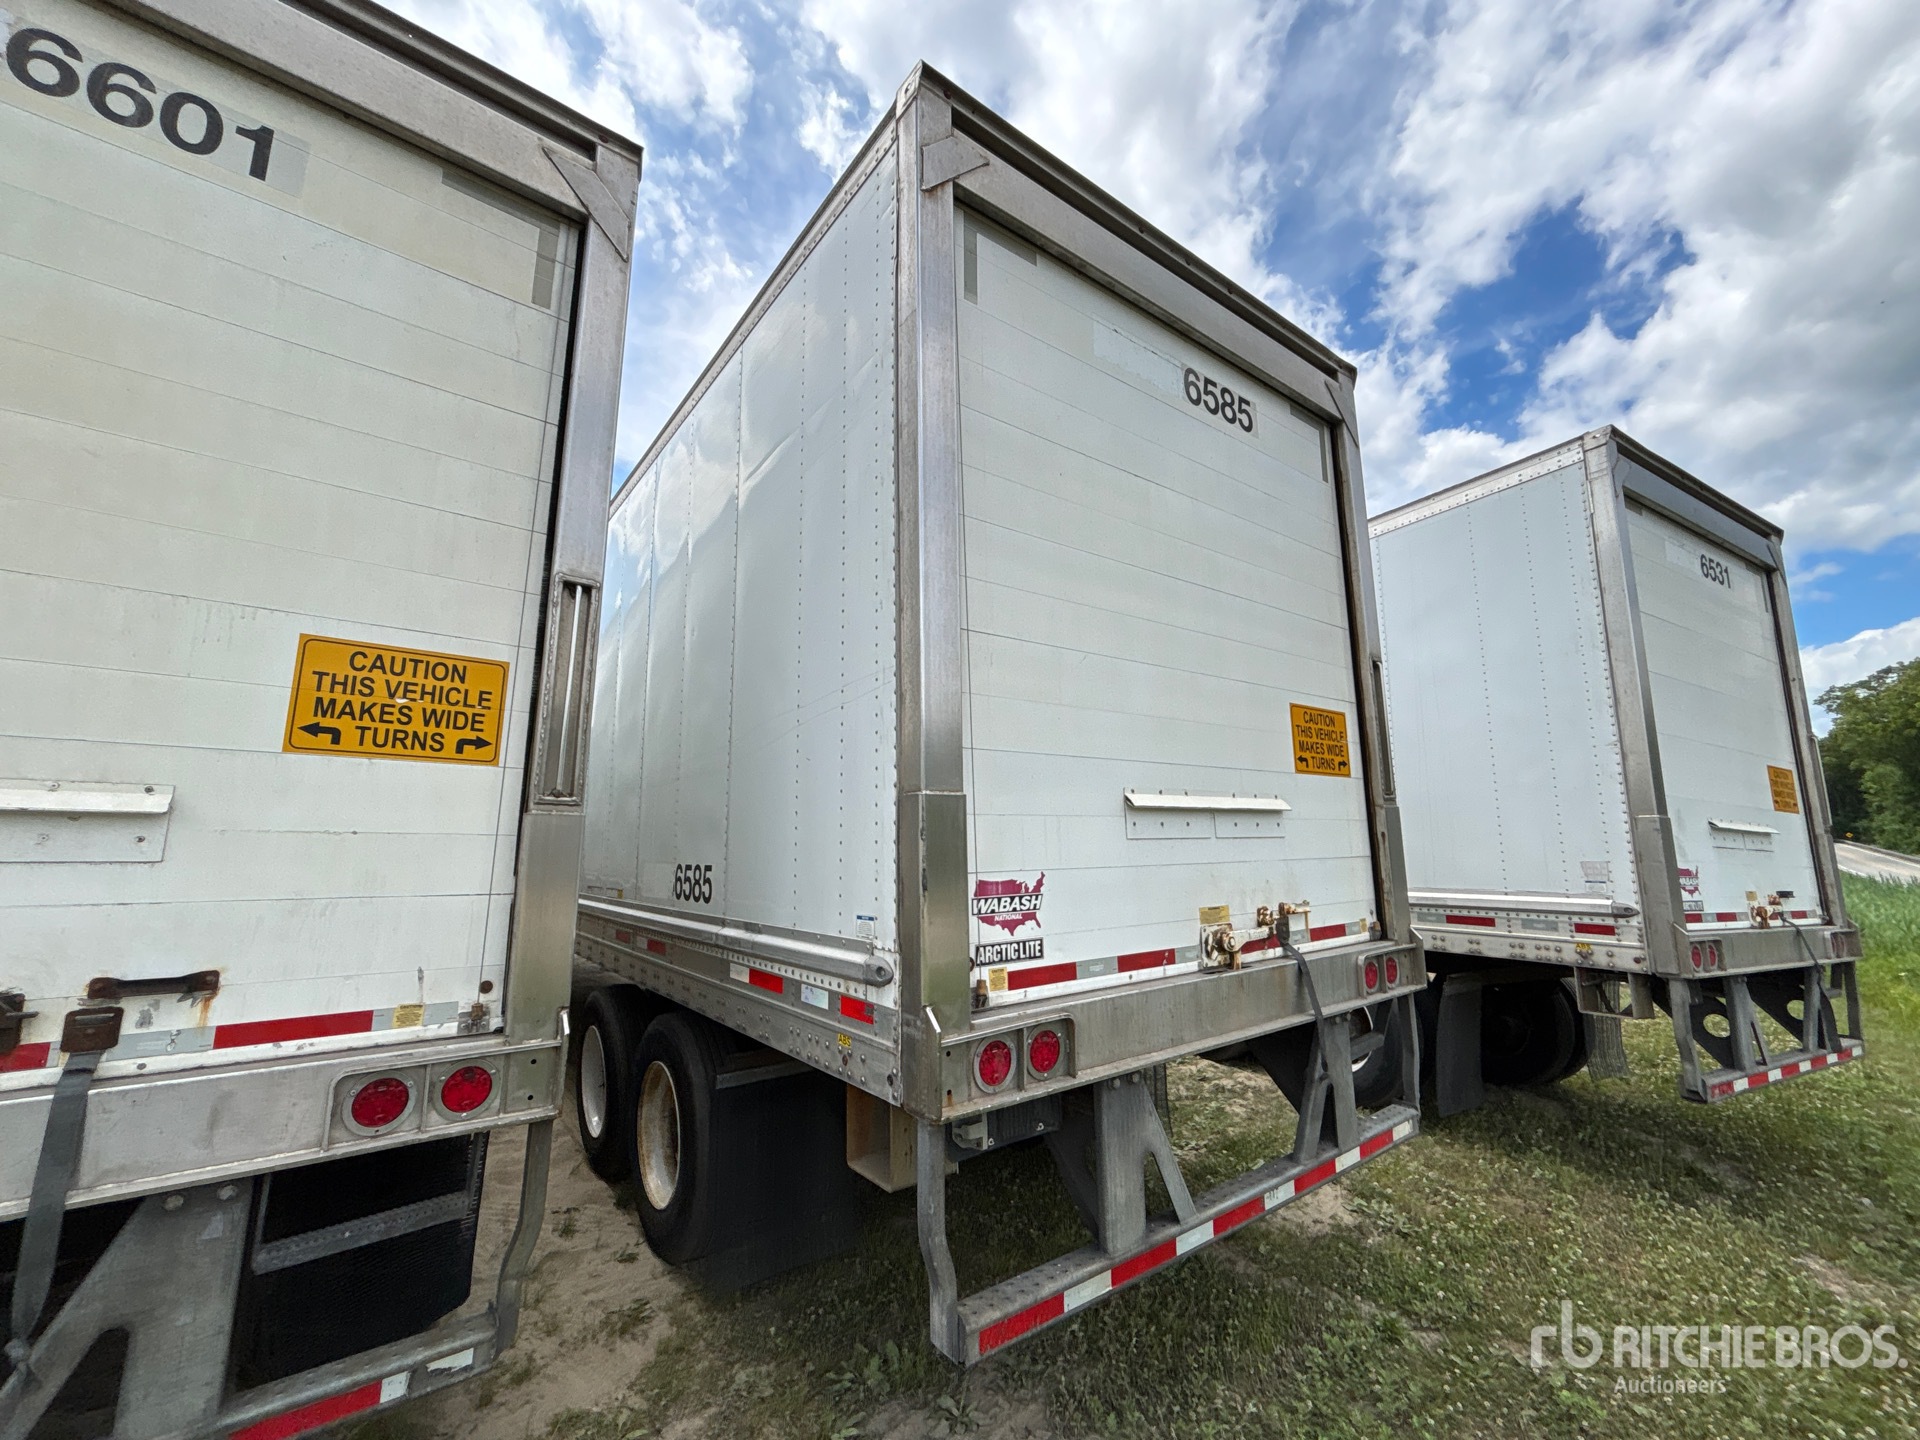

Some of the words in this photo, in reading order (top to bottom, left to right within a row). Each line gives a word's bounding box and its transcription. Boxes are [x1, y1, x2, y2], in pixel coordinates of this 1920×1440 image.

[6, 28, 274, 181] 6601
[1184, 367, 1253, 433] 6585
[1700, 554, 1731, 589] 6531
[349, 651, 467, 684] CAUTION
[312, 670, 375, 698] THIS
[385, 679, 493, 710] VEHICLE
[313, 697, 413, 725] MAKES
[422, 707, 485, 732] WIDE
[1303, 711, 1335, 727] CAUTION
[355, 725, 445, 752] TURNS
[1295, 724, 1313, 739] THIS
[1314, 728, 1344, 743] VEHICLE
[1298, 740, 1325, 755] MAKES
[1326, 744, 1344, 758] WIDE
[1311, 756, 1336, 771] TURNS
[674, 863, 713, 904] 6585
[972, 895, 1042, 915] WABASH
[838, 1033, 851, 1047] ABS
